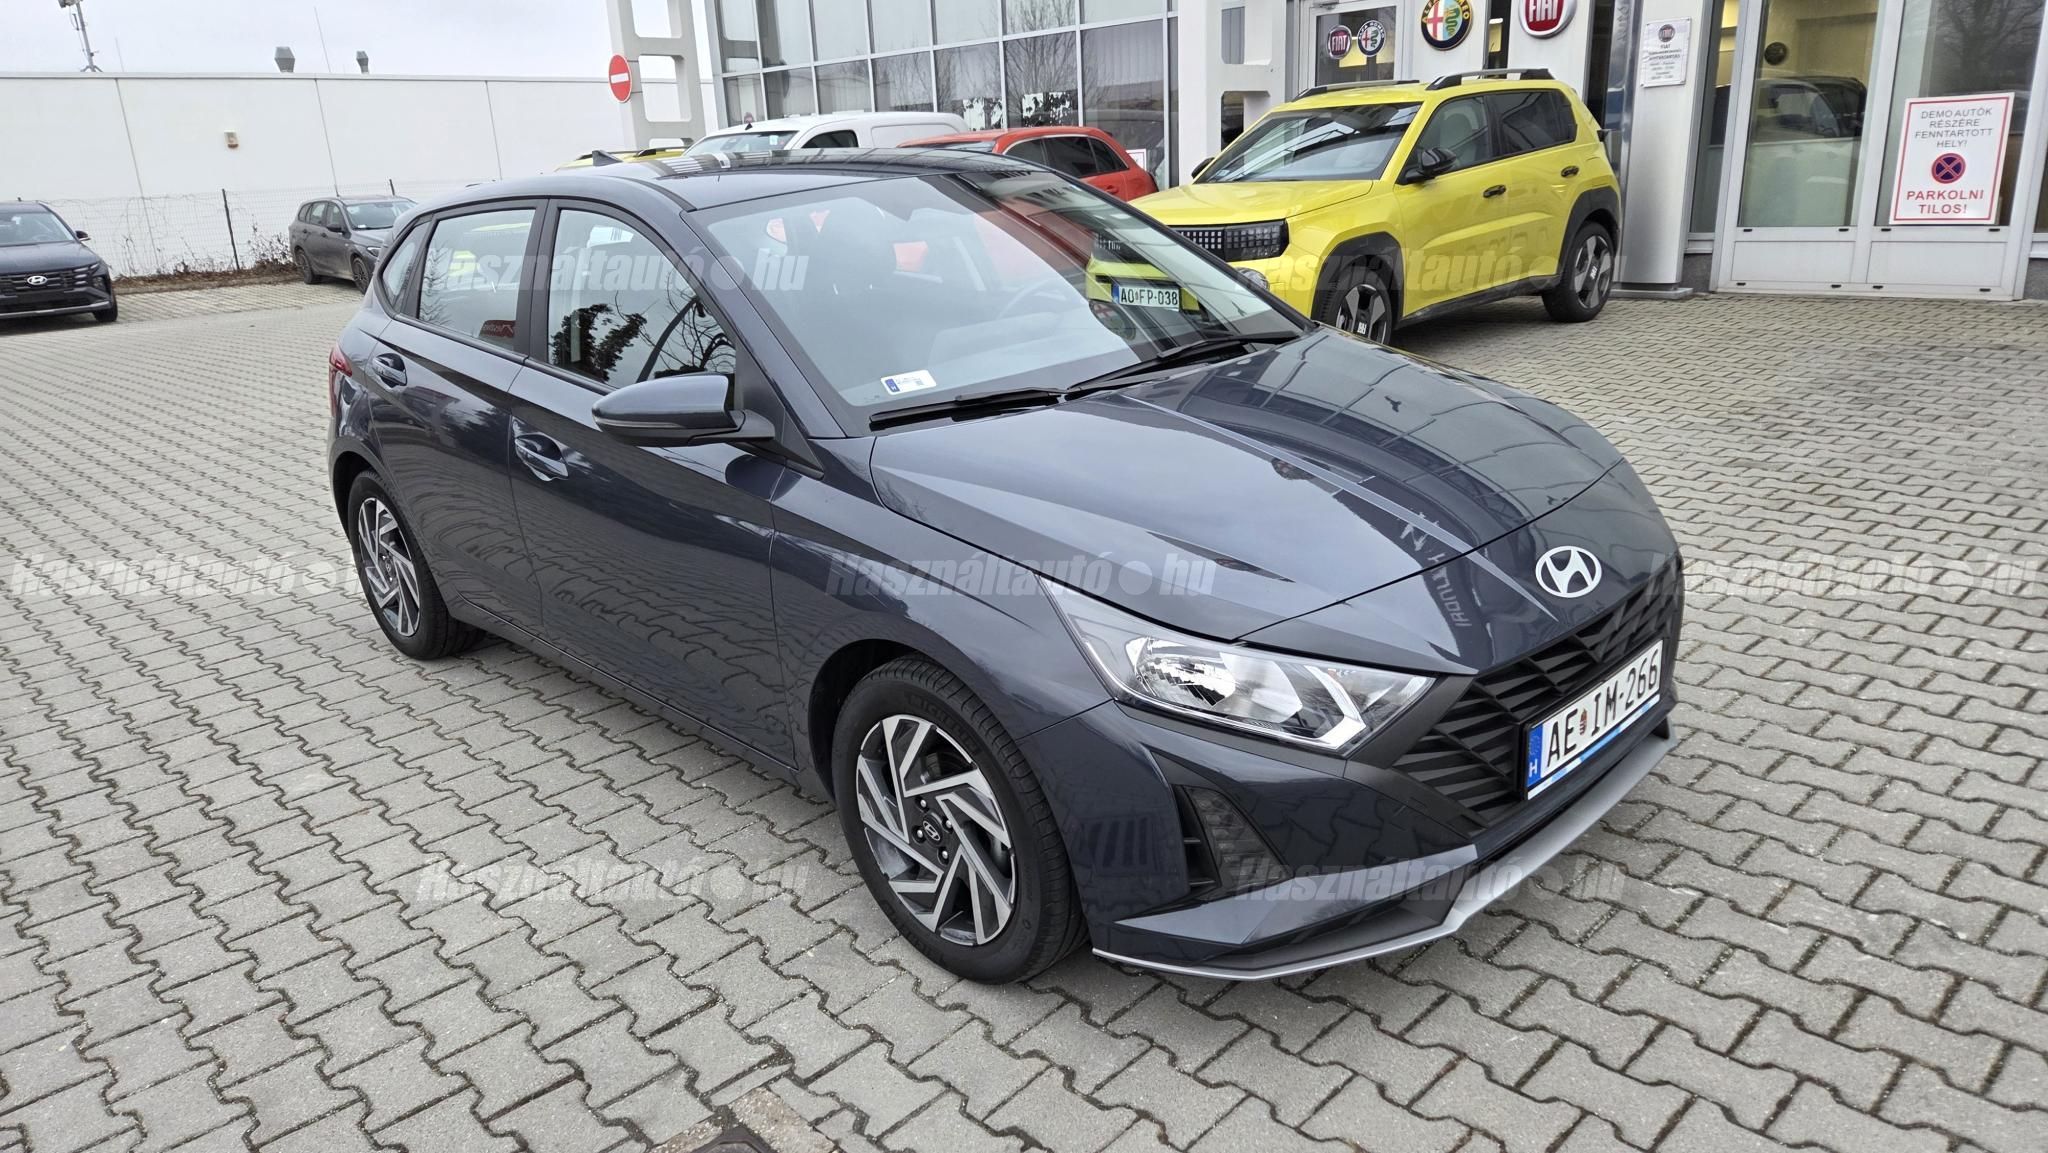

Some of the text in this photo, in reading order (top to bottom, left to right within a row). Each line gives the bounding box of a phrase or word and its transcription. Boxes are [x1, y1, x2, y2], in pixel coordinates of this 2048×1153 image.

[1331, 34, 1347, 51] FIAT
[1920, 107, 1993, 119] DEMO AUTÓK
[1929, 118, 1981, 129] RÉSZÉRE
[1914, 128, 1993, 139] FENNTARTOTT
[1936, 139, 1968, 148] HELY!
[1906, 189, 1985, 201] PARKOLNI
[1918, 203, 1968, 214] TILOS!
